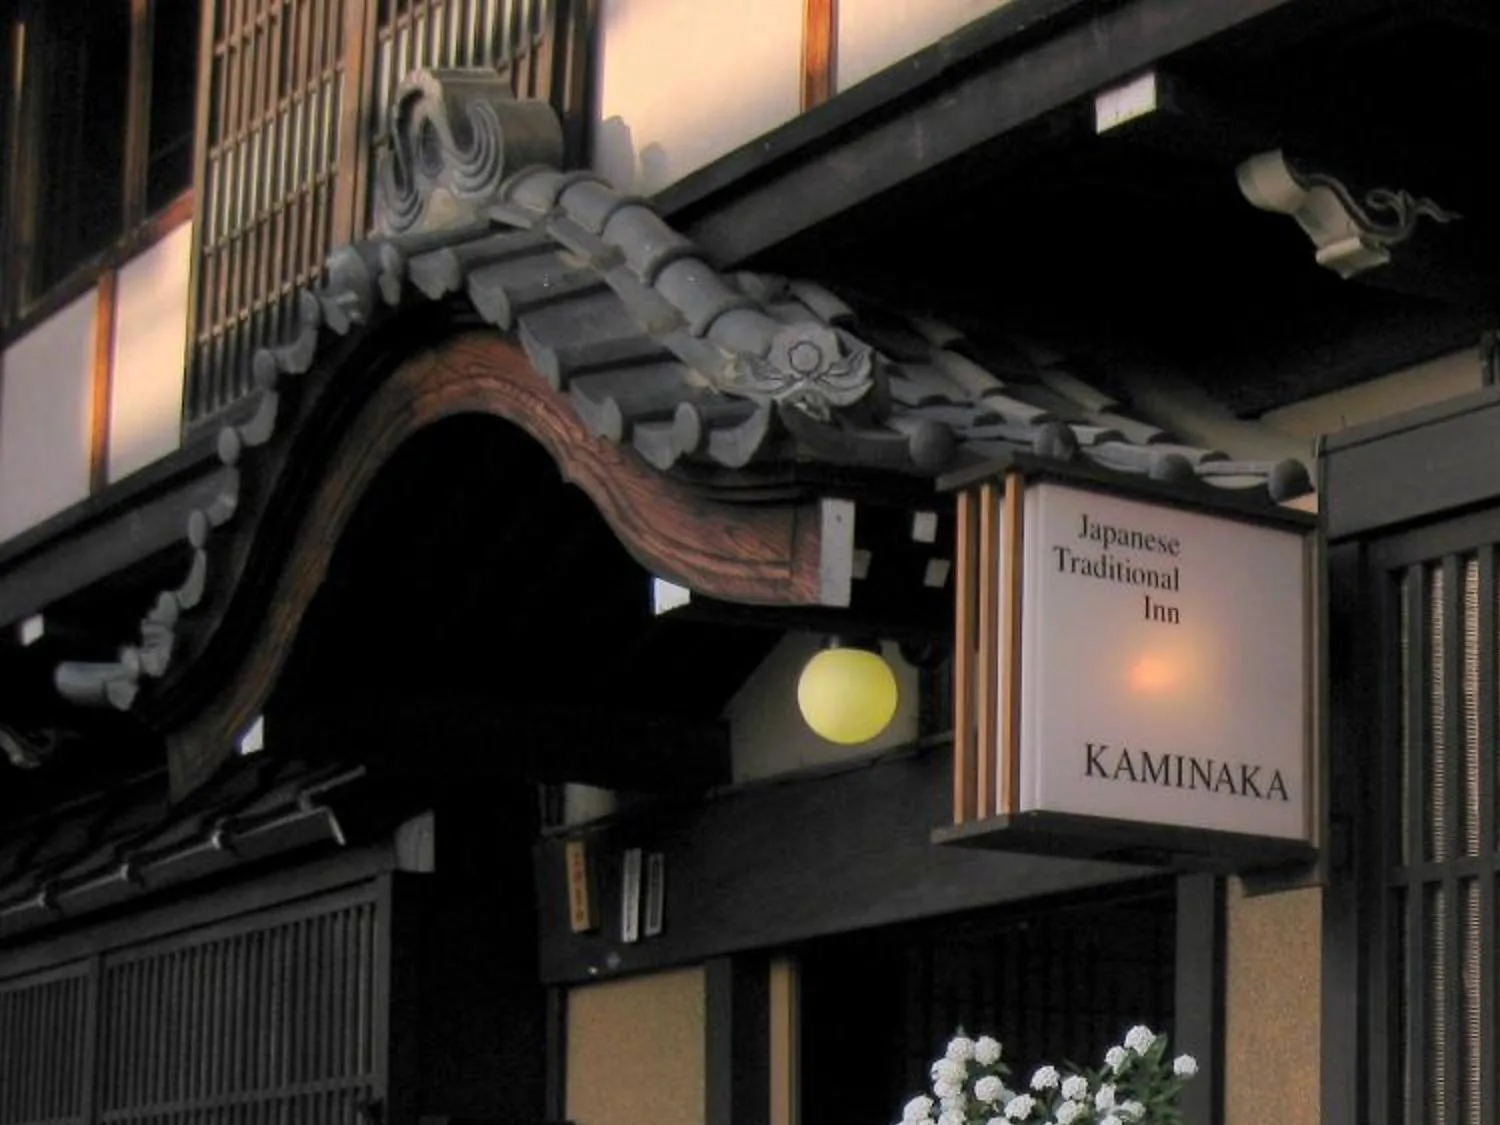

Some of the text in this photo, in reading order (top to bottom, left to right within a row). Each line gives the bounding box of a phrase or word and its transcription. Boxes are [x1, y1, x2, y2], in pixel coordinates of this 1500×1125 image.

[1078, 514, 1181, 556] Japanese
[1053, 546, 1180, 592] Traditional
[1144, 595, 1180, 625] Inn
[1084, 742, 1289, 801] KAMINAKA
